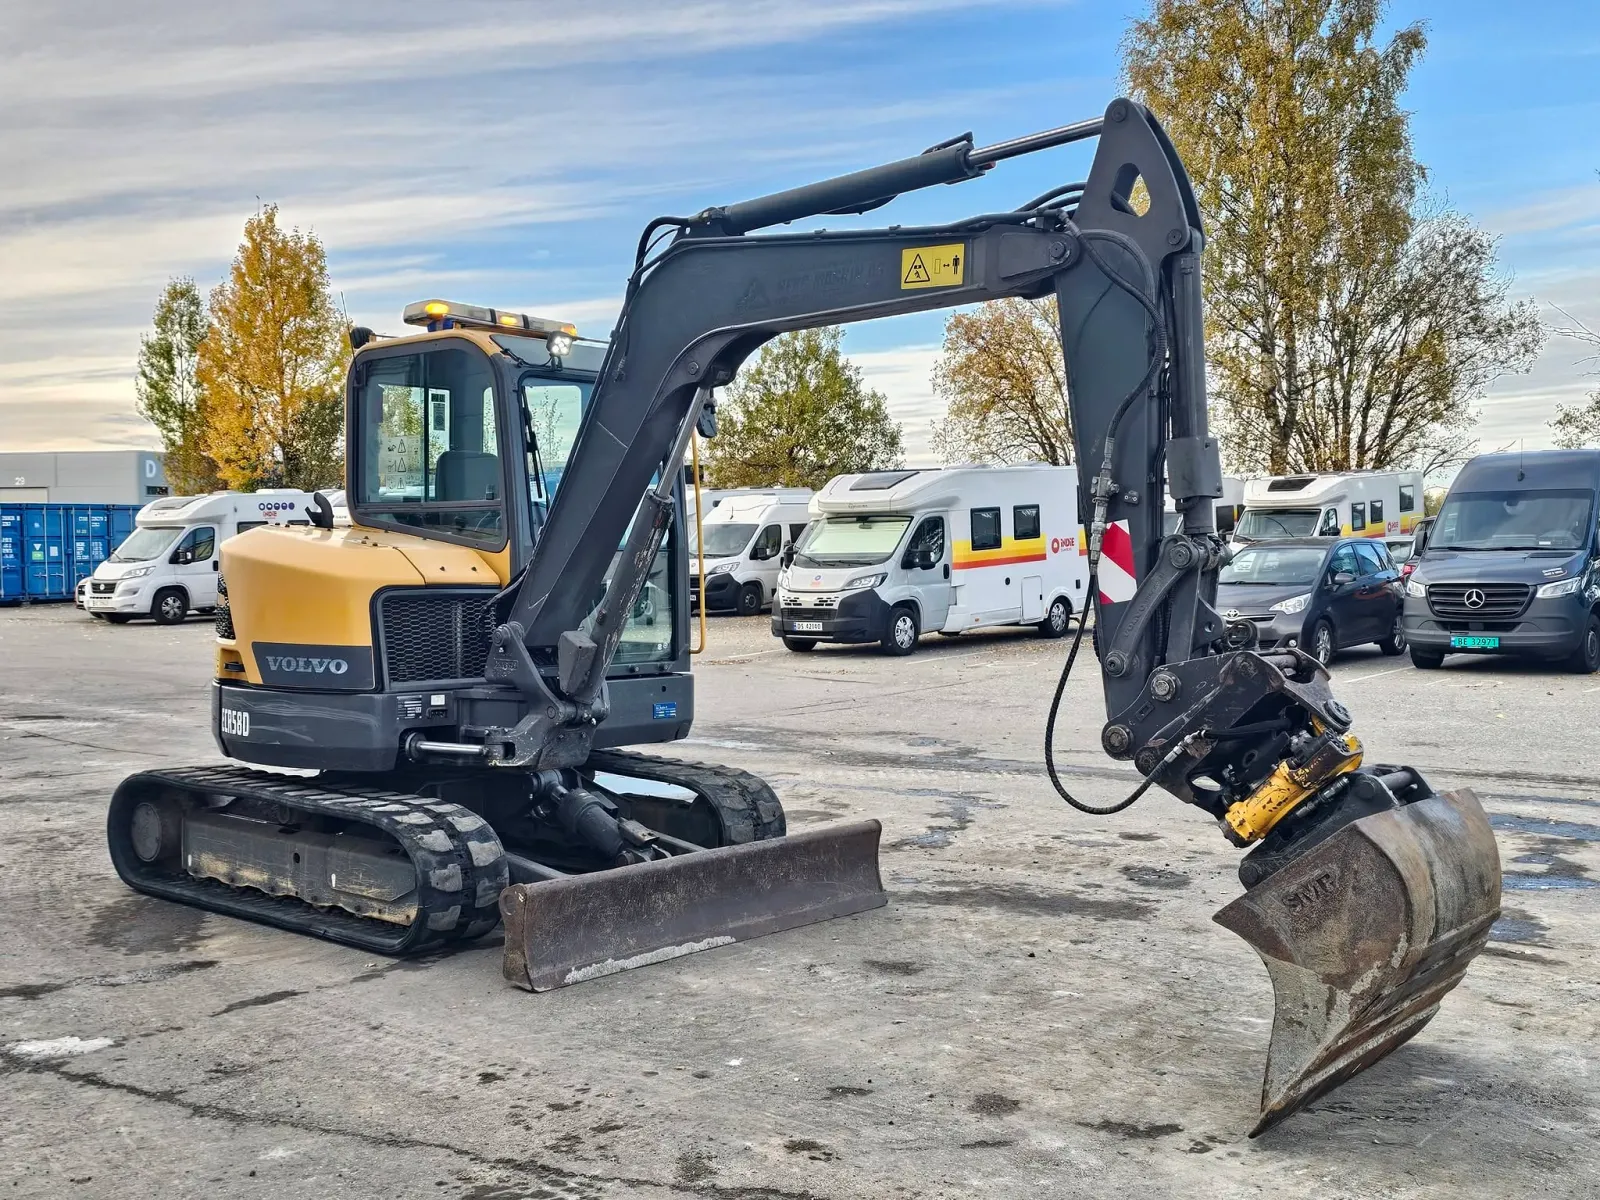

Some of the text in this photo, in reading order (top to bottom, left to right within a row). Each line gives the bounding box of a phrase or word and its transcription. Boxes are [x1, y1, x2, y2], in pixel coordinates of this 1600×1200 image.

[145, 460, 156, 478] D
[14, 476, 25, 486] 29
[1457, 637, 1497, 646] BE 32971
[265, 655, 349, 675] VOLVO
[221, 707, 250, 737] ECR58D
